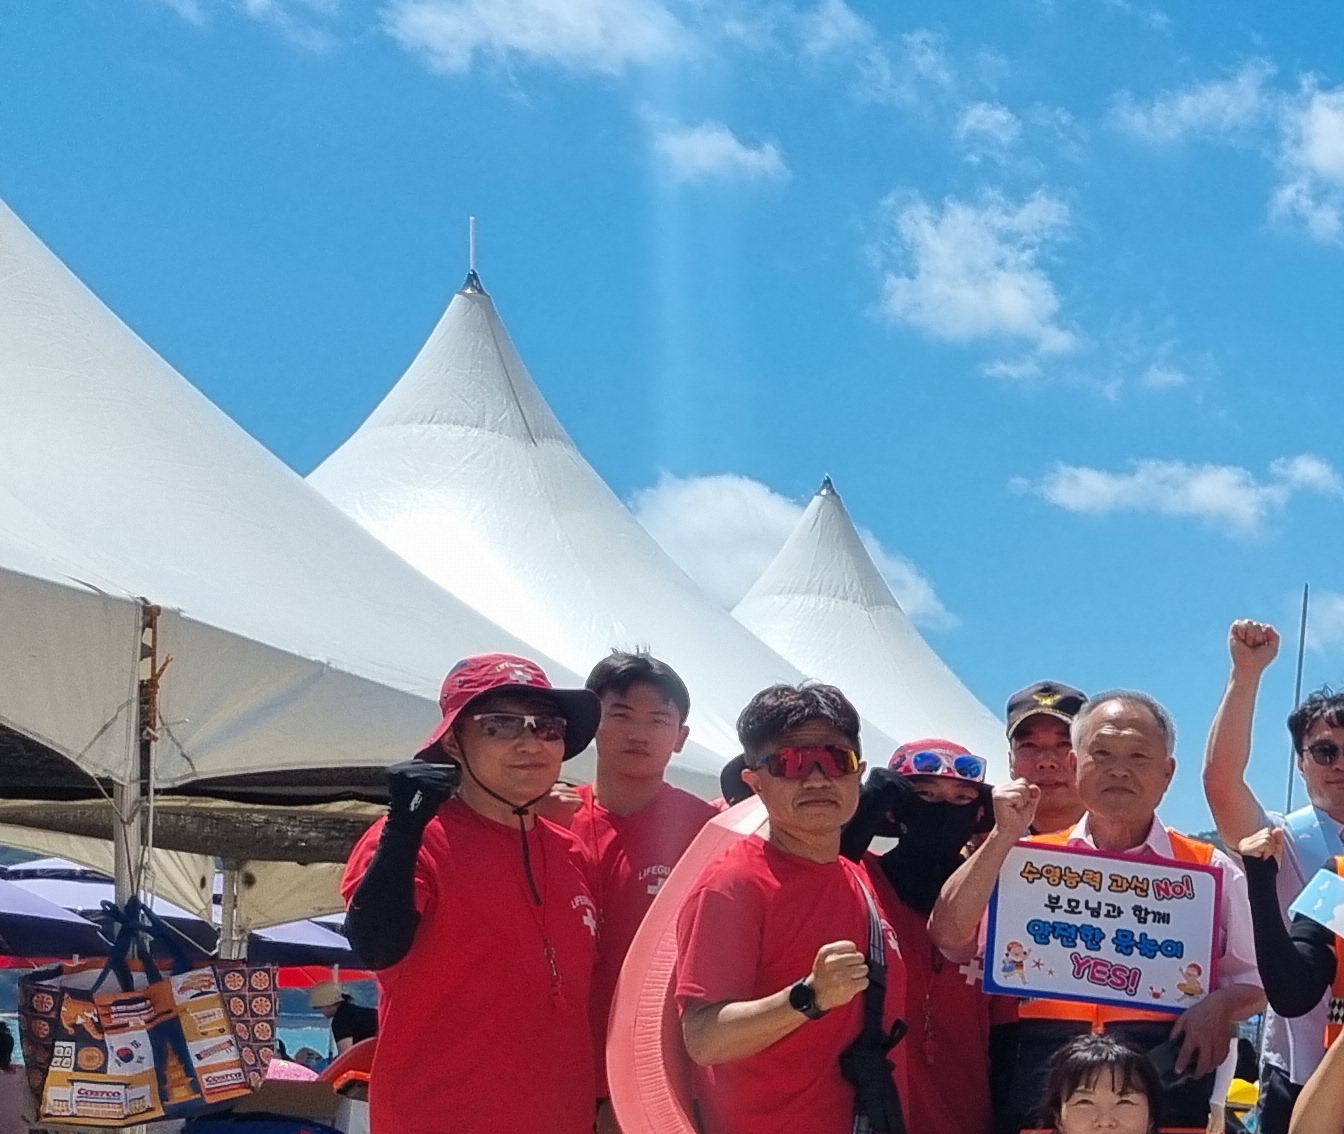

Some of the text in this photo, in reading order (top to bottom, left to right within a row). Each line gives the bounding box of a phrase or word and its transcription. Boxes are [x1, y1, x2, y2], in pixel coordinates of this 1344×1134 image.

[1019, 861, 1195, 900] 수영능력 과신 NO!
[1044, 894, 1171, 925] 부모님과 함께
[1026, 919, 1185, 959] 안전한 물놀이
[1070, 952, 1142, 996] YES!
[76, 1087, 121, 1097] COSTCO
